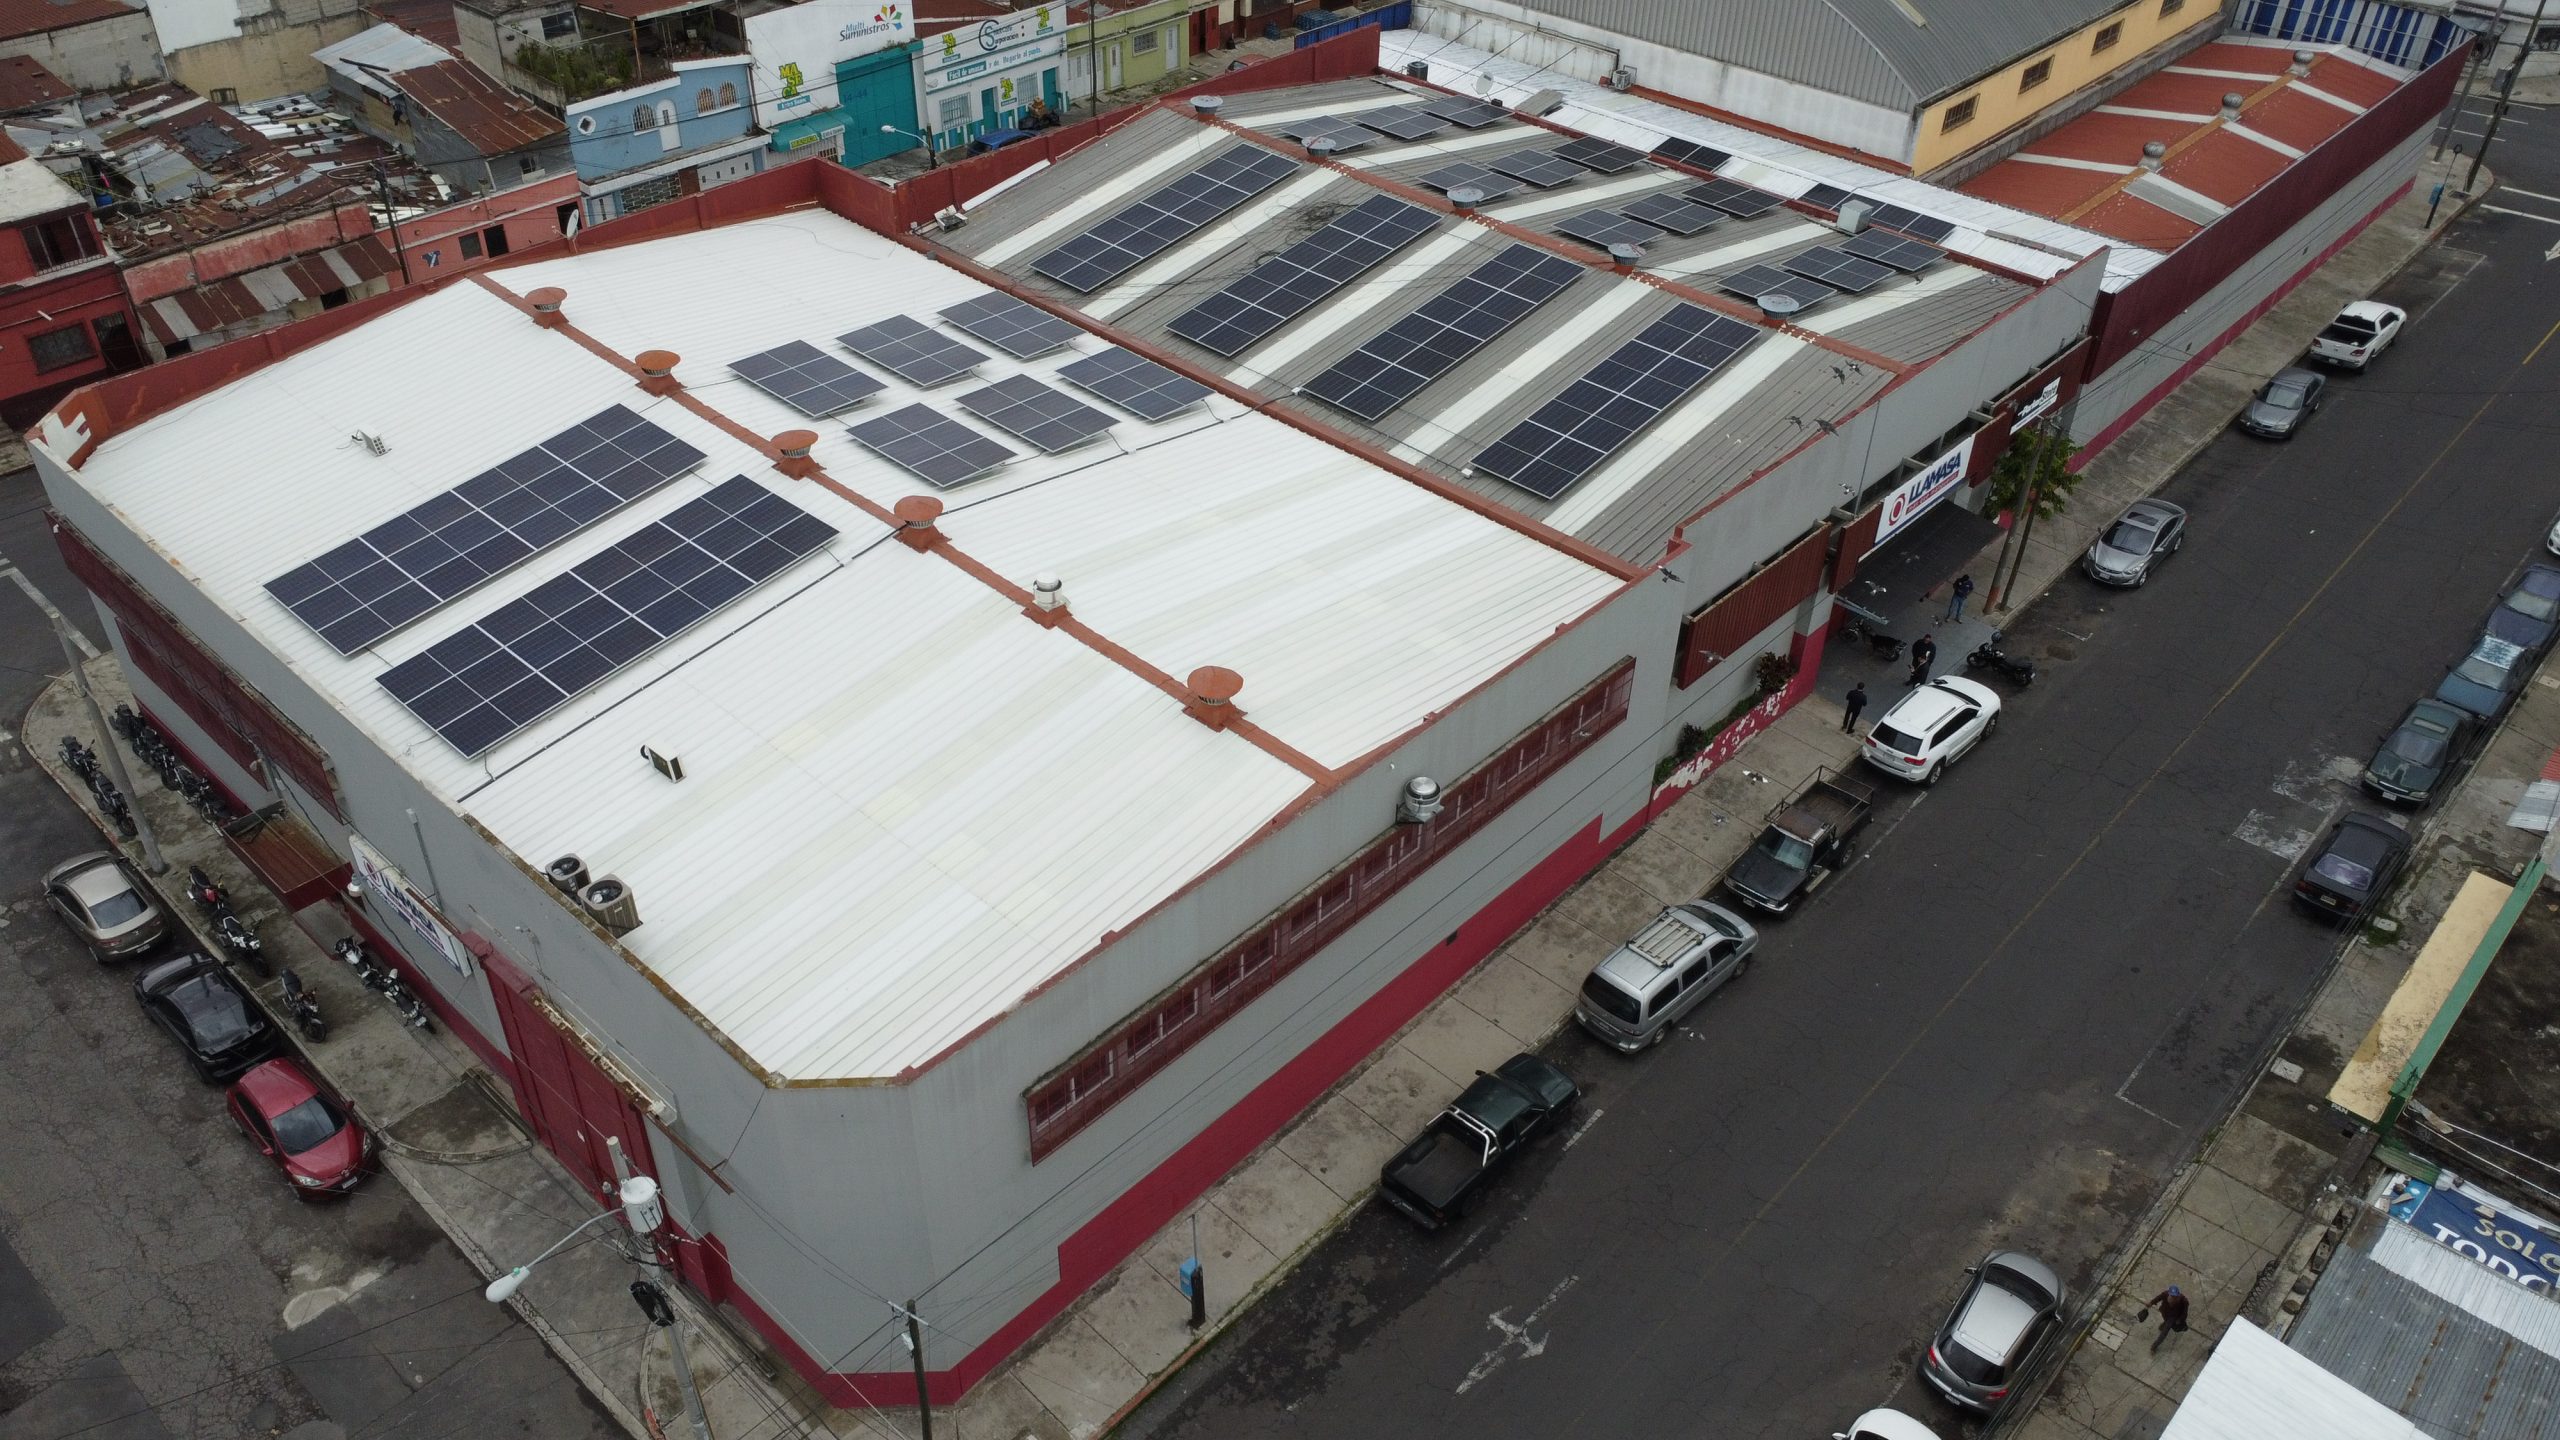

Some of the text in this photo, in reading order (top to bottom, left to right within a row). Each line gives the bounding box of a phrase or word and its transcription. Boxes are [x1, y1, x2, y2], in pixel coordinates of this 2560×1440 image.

[839, 22, 890, 42] Suministros
[845, 21, 865, 32] Multi
[1908, 451, 1961, 504] LLAMASA
